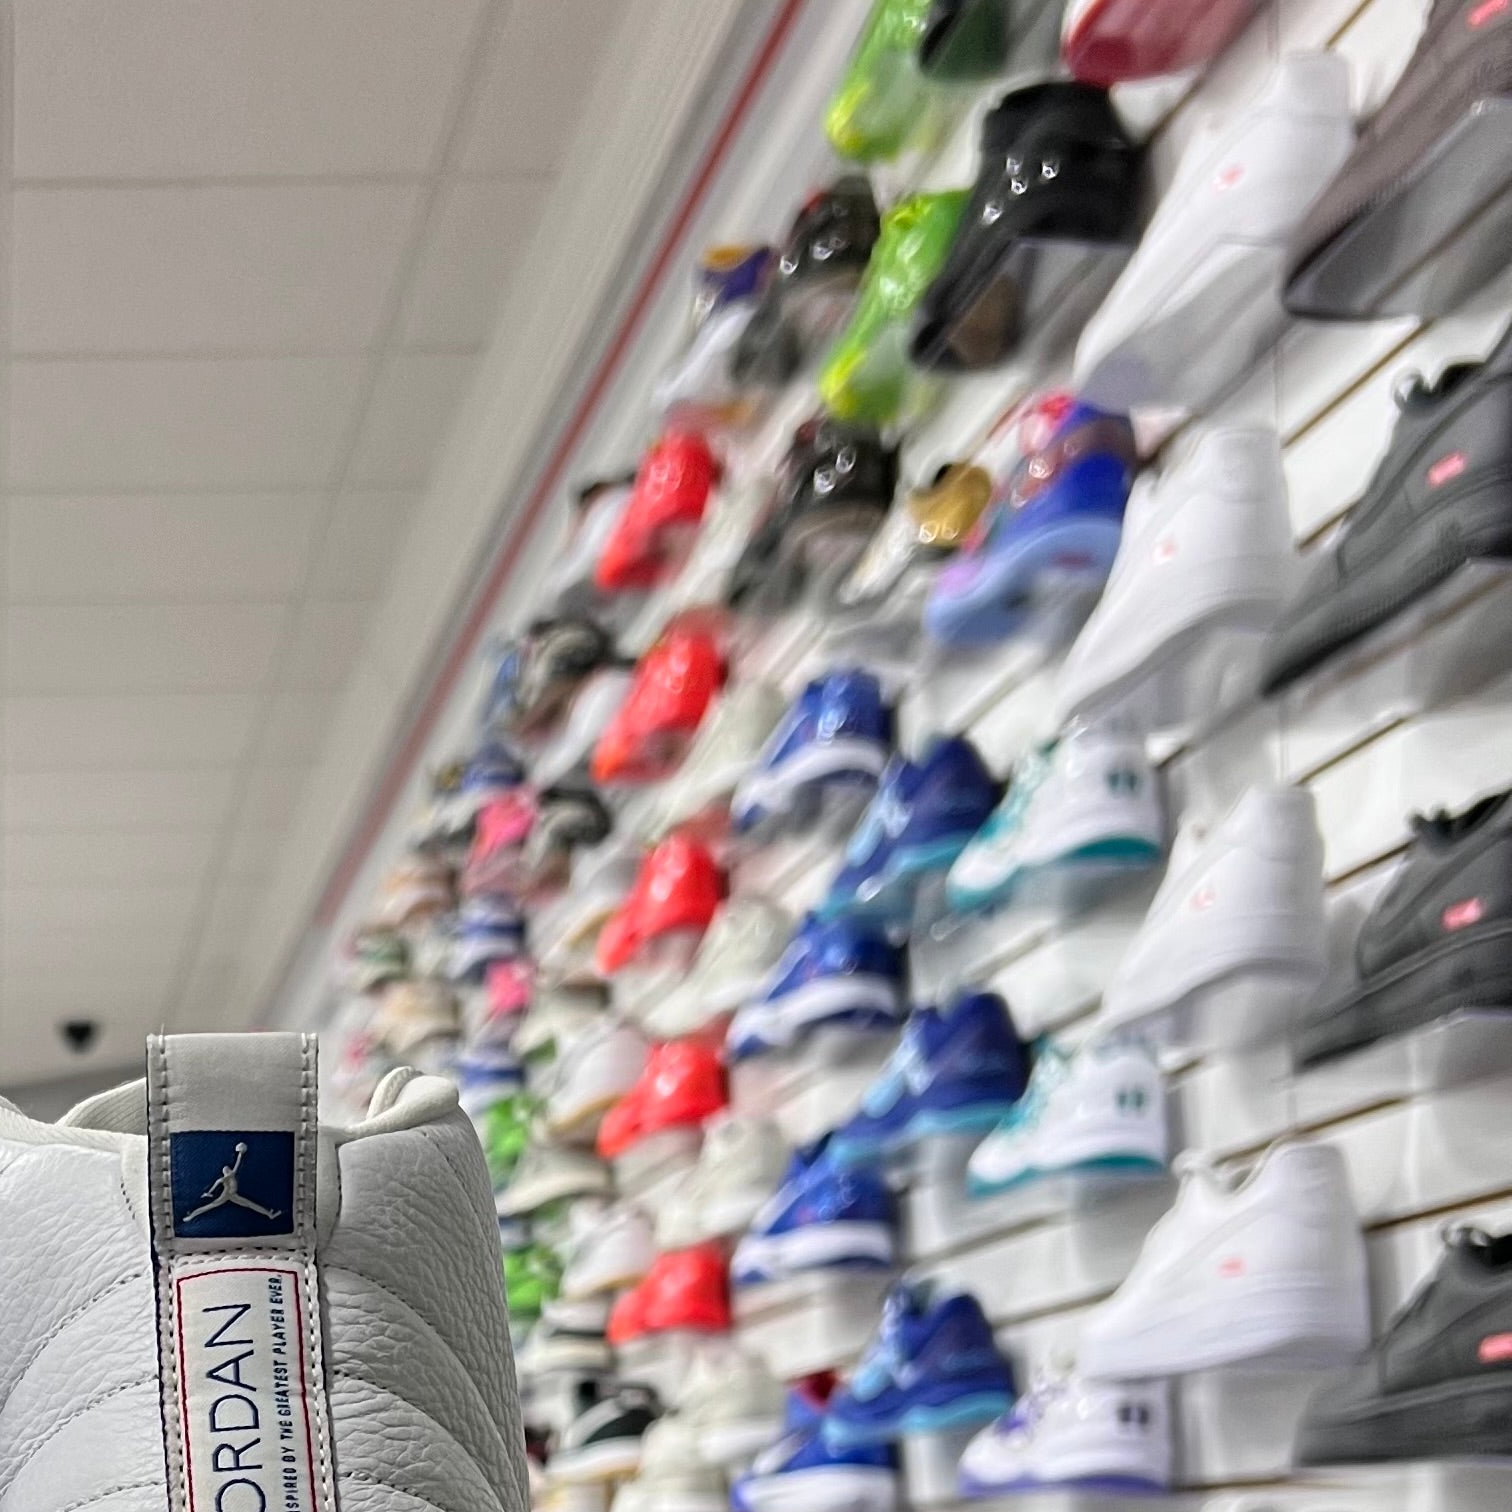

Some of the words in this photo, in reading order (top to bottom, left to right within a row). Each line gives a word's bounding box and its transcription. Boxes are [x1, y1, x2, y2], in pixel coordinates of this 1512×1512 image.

[268, 1274, 284, 1304] EVER.
[270, 1309, 287, 1355] PLAYER
[272, 1360, 292, 1417] GREATEST
[279, 1420, 293, 1440] THE
[281, 1446, 296, 1462] BY
